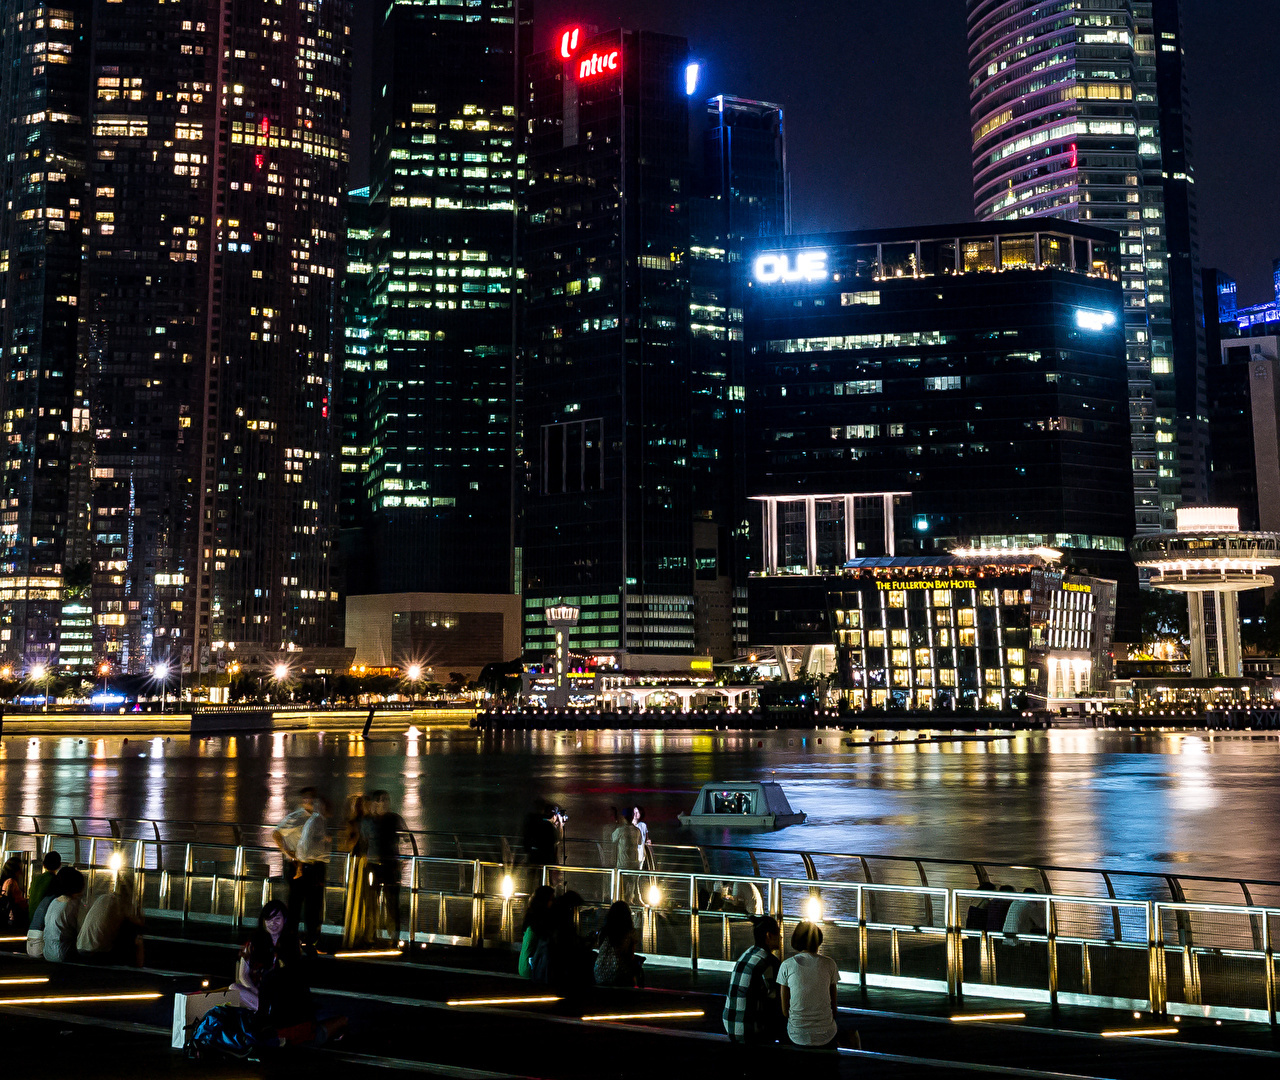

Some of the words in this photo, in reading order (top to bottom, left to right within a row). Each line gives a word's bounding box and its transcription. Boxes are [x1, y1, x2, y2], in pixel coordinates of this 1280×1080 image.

[579, 51, 618, 78] ntuc
[755, 251, 828, 282] OUE
[876, 581, 891, 590] THE
